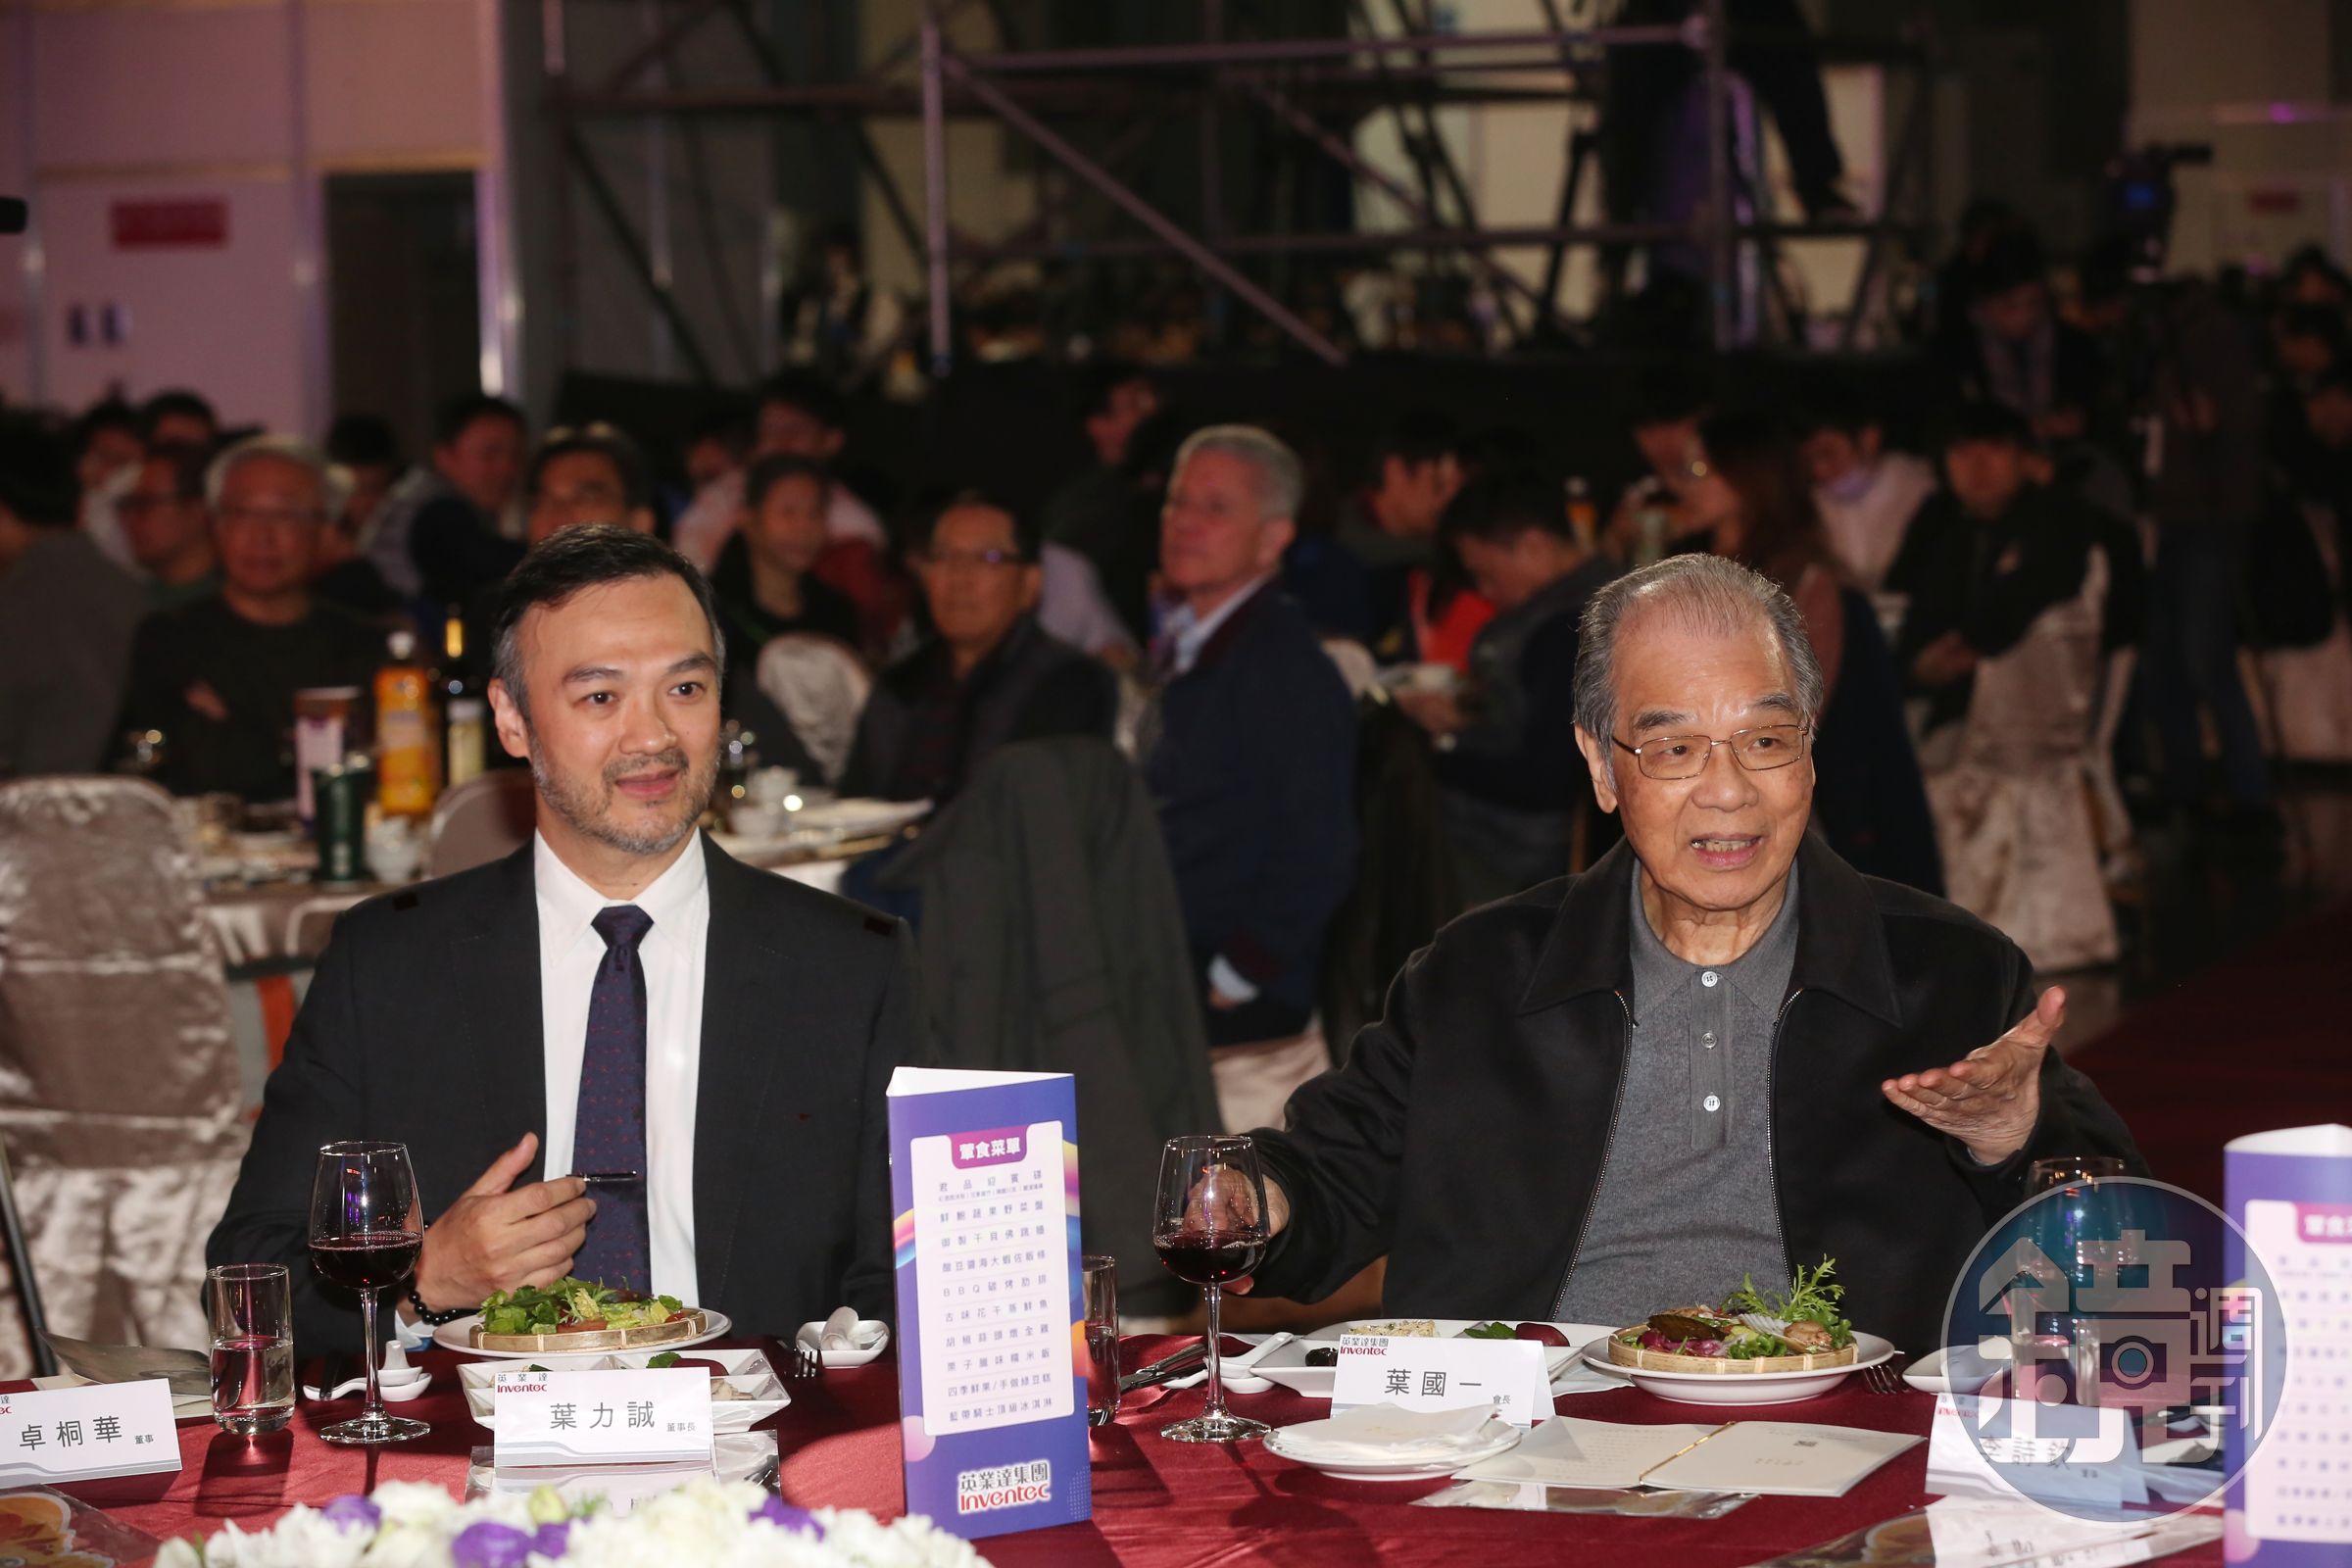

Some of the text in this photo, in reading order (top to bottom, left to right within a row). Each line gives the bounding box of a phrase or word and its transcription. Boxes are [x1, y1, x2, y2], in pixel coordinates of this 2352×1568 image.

[958, 1136, 1021, 1161] 葷食菜單
[1340, 1346, 1388, 1356] Inventec
[1342, 1336, 1390, 1348] 英業達集團
[497, 1372, 549, 1383] 英業達
[497, 1384, 549, 1394] Inventec
[1384, 1368, 1511, 1405] 葉國一 會長
[550, 1400, 697, 1433] 葉力誠 董事長
[20, 1415, 155, 1451] 卓桐華 董事
[960, 1461, 1049, 1493] 英業達集團
[960, 1482, 1051, 1511] Inventec
